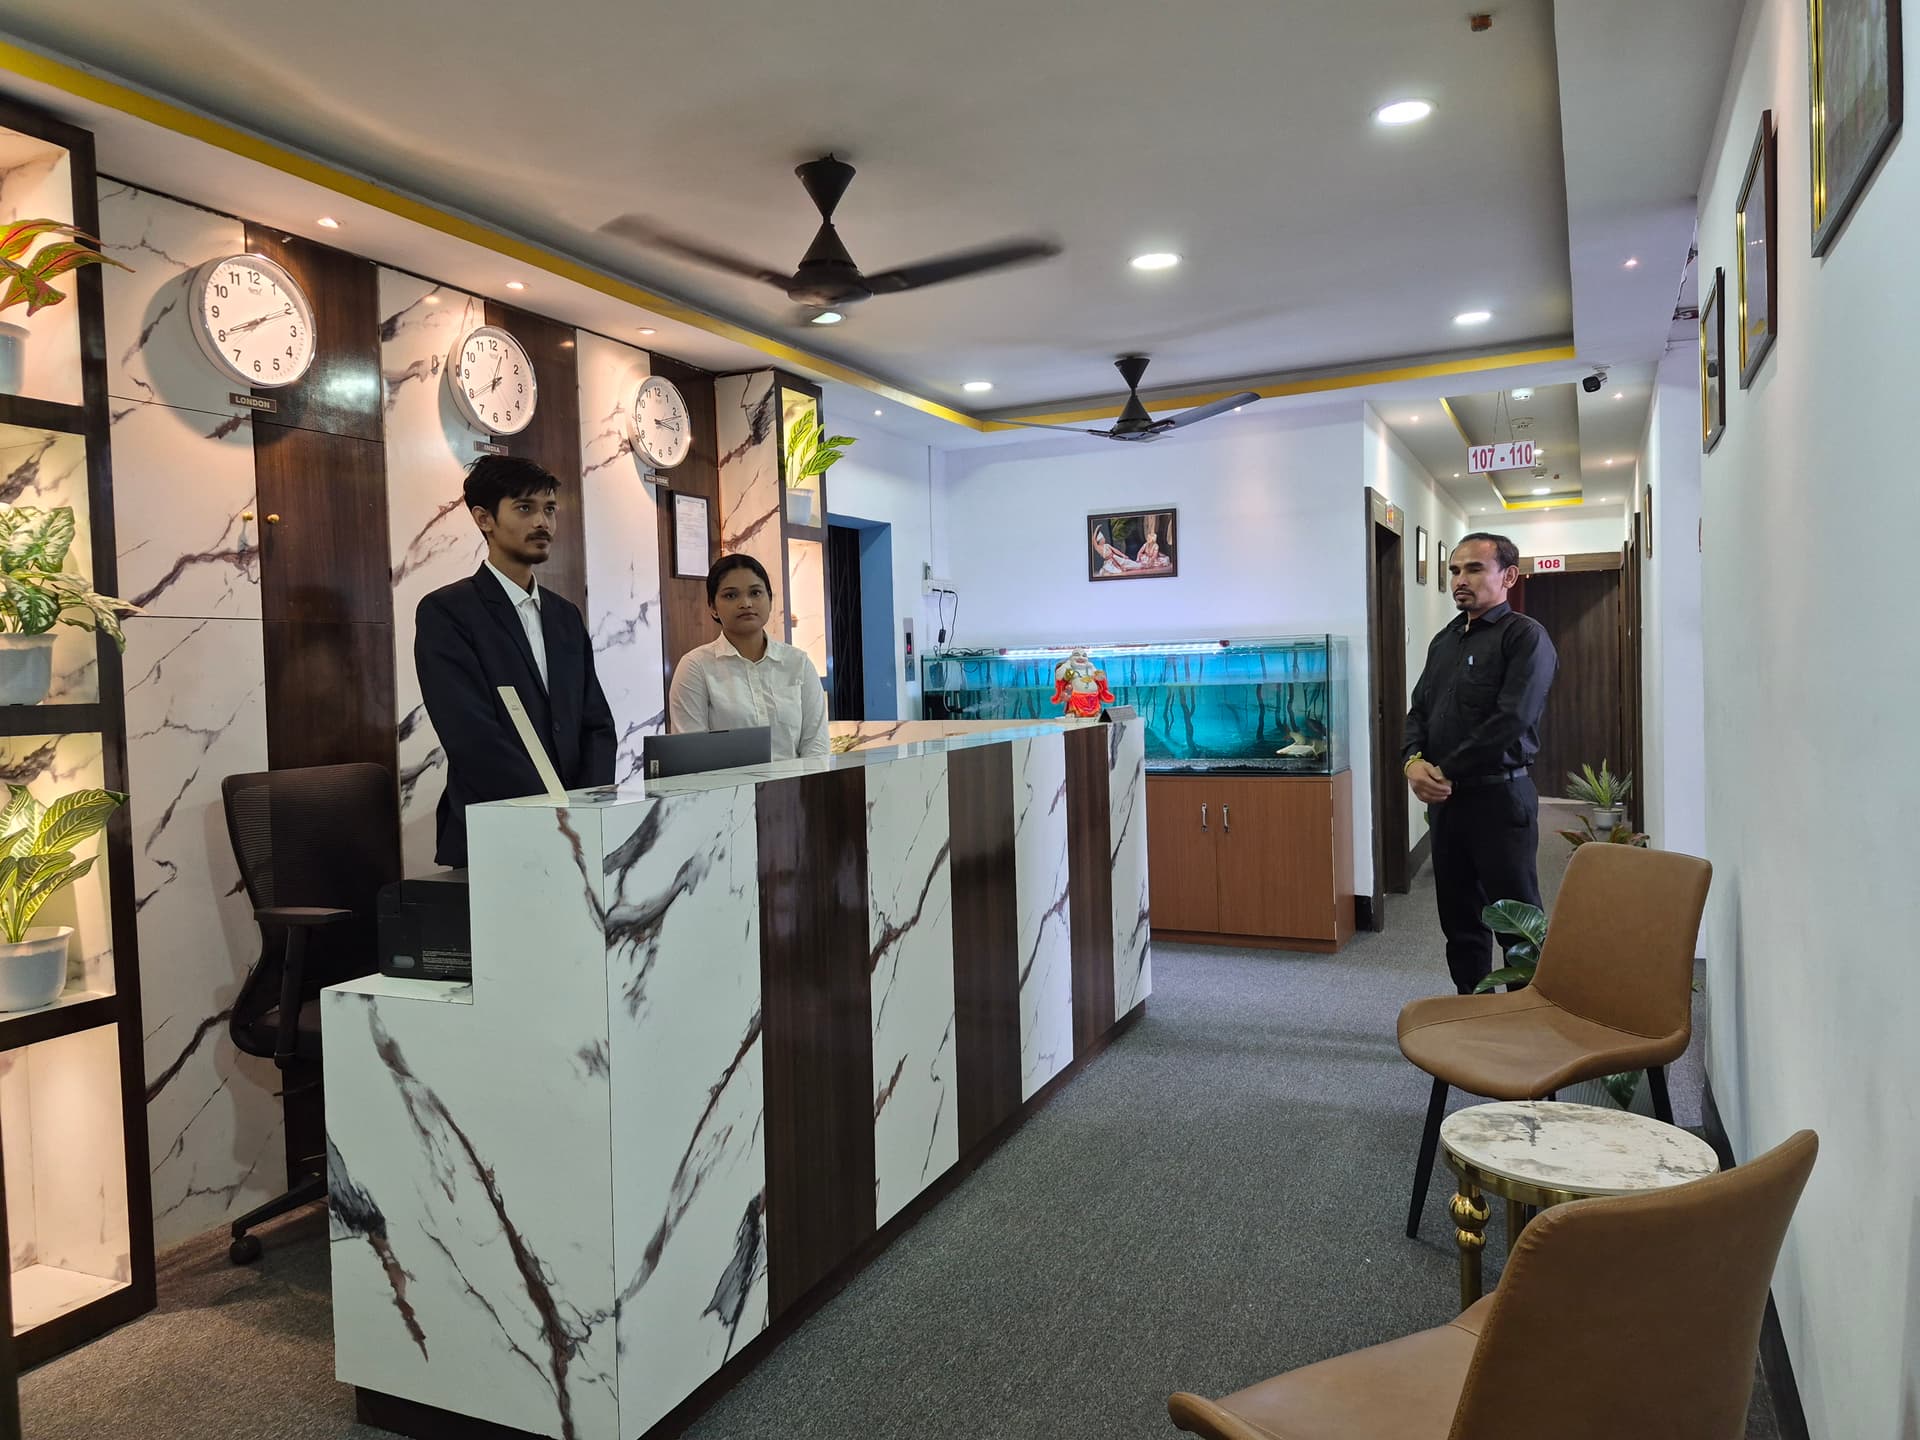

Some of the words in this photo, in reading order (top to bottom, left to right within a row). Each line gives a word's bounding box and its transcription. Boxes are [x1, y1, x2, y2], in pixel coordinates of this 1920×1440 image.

[229, 272, 240, 286] 11
[248, 271, 260, 285] 12
[214, 284, 228, 298] 10
[272, 283, 276, 296] 1
[211, 306, 220, 318] 9
[284, 303, 292, 315] 2
[218, 330, 226, 342] 8
[290, 326, 297, 337] 3
[476, 341, 484, 352] 11
[489, 340, 497, 351] 12
[233, 349, 241, 362] 7
[286, 346, 293, 358] 4
[466, 352, 476, 362] 10
[504, 350, 508, 360] 1
[254, 360, 262, 372] 6
[273, 359, 280, 371] 5
[514, 364, 518, 375] 2
[464, 369, 470, 379] 9
[469, 388, 474, 399] 8
[518, 384, 522, 394] 3
[645, 388, 650, 398] 11
[654, 388, 661, 397] 12
[235, 395, 271, 409] LONDON
[666, 394, 668, 403] 1
[480, 404, 484, 414] 7
[514, 400, 520, 410] 4
[506, 411, 512, 420] 5
[672, 408, 676, 416] 2
[493, 413, 498, 422] 6
[638, 414, 642, 422] 9
[676, 422, 680, 432] 3
[642, 430, 646, 439] 8
[648, 443, 652, 452] 7
[668, 446, 672, 456] 5
[659, 449, 662, 458] 6
[1472, 448, 1495, 469] 107
[1509, 444, 1532, 466] 110
[1538, 560, 1560, 568] 108
